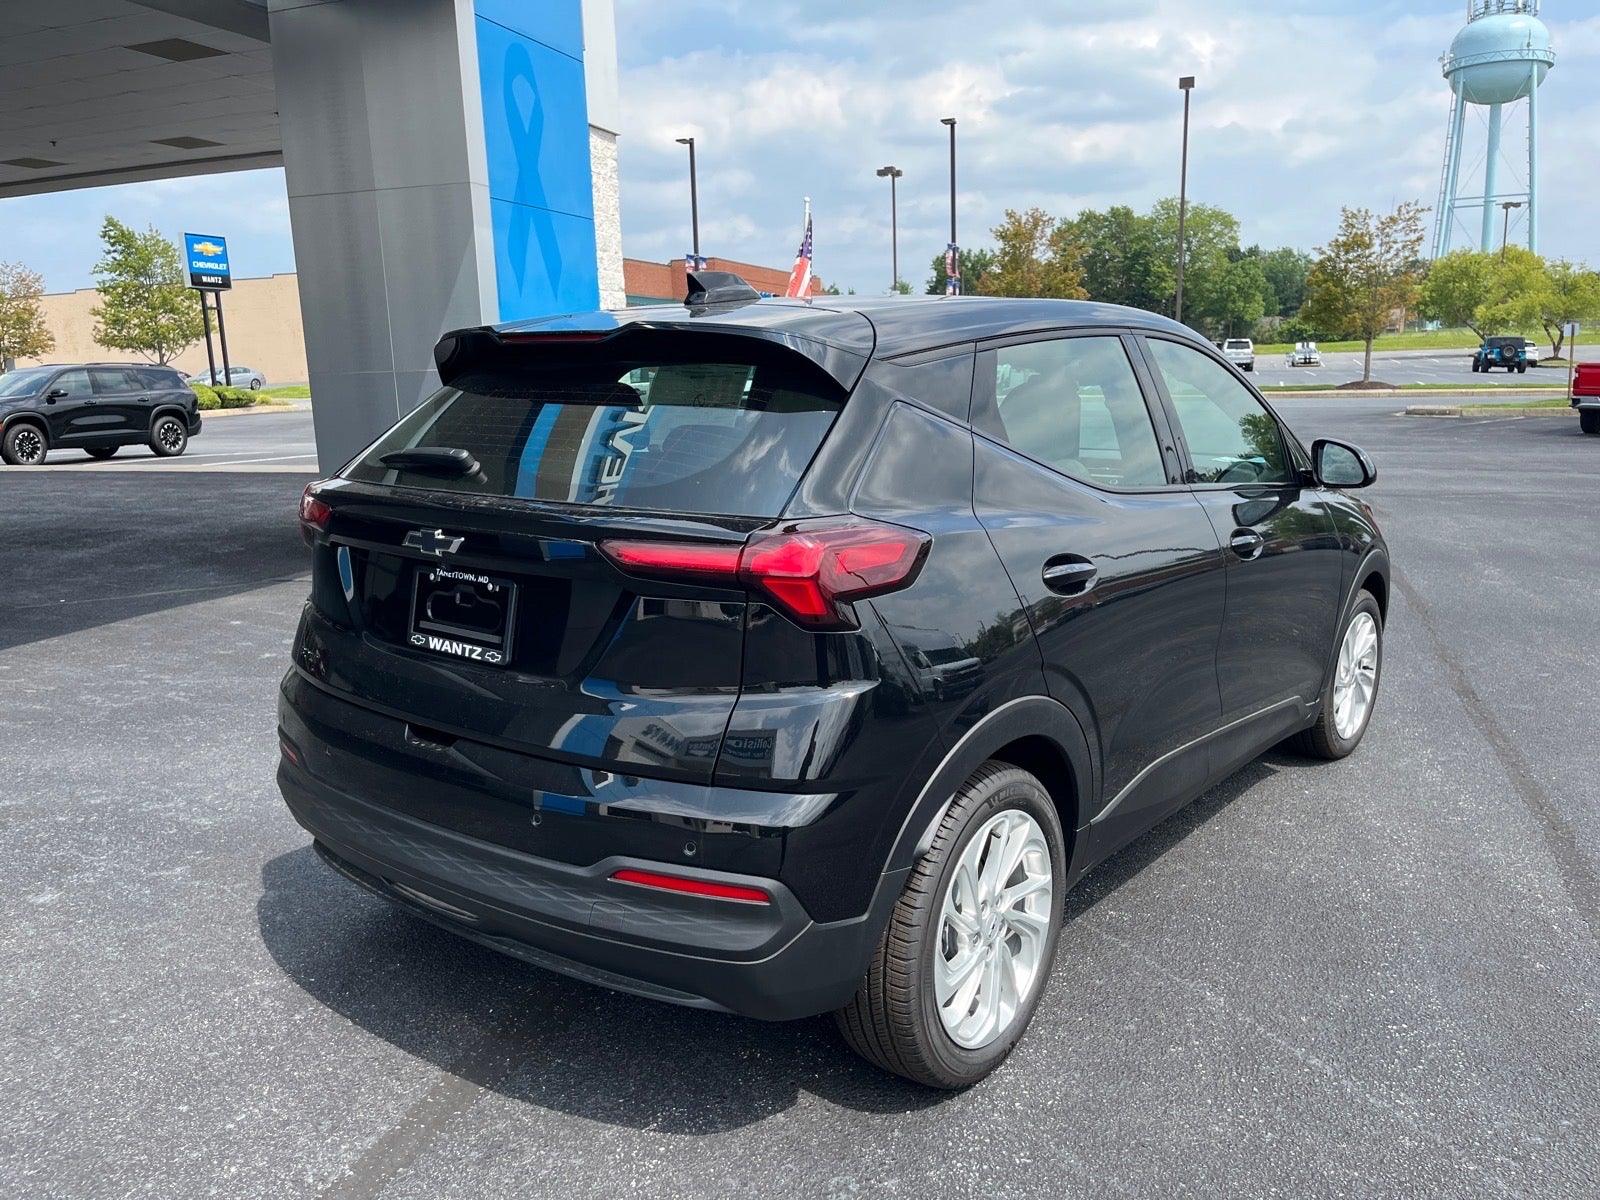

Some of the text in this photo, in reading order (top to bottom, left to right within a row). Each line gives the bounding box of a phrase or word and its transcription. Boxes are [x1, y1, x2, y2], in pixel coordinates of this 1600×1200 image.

[192, 260, 228, 270] CHEVROLET
[201, 275, 223, 284] WANTZ
[477, 575, 489, 584] MD
[428, 636, 483, 660] WANTZ
